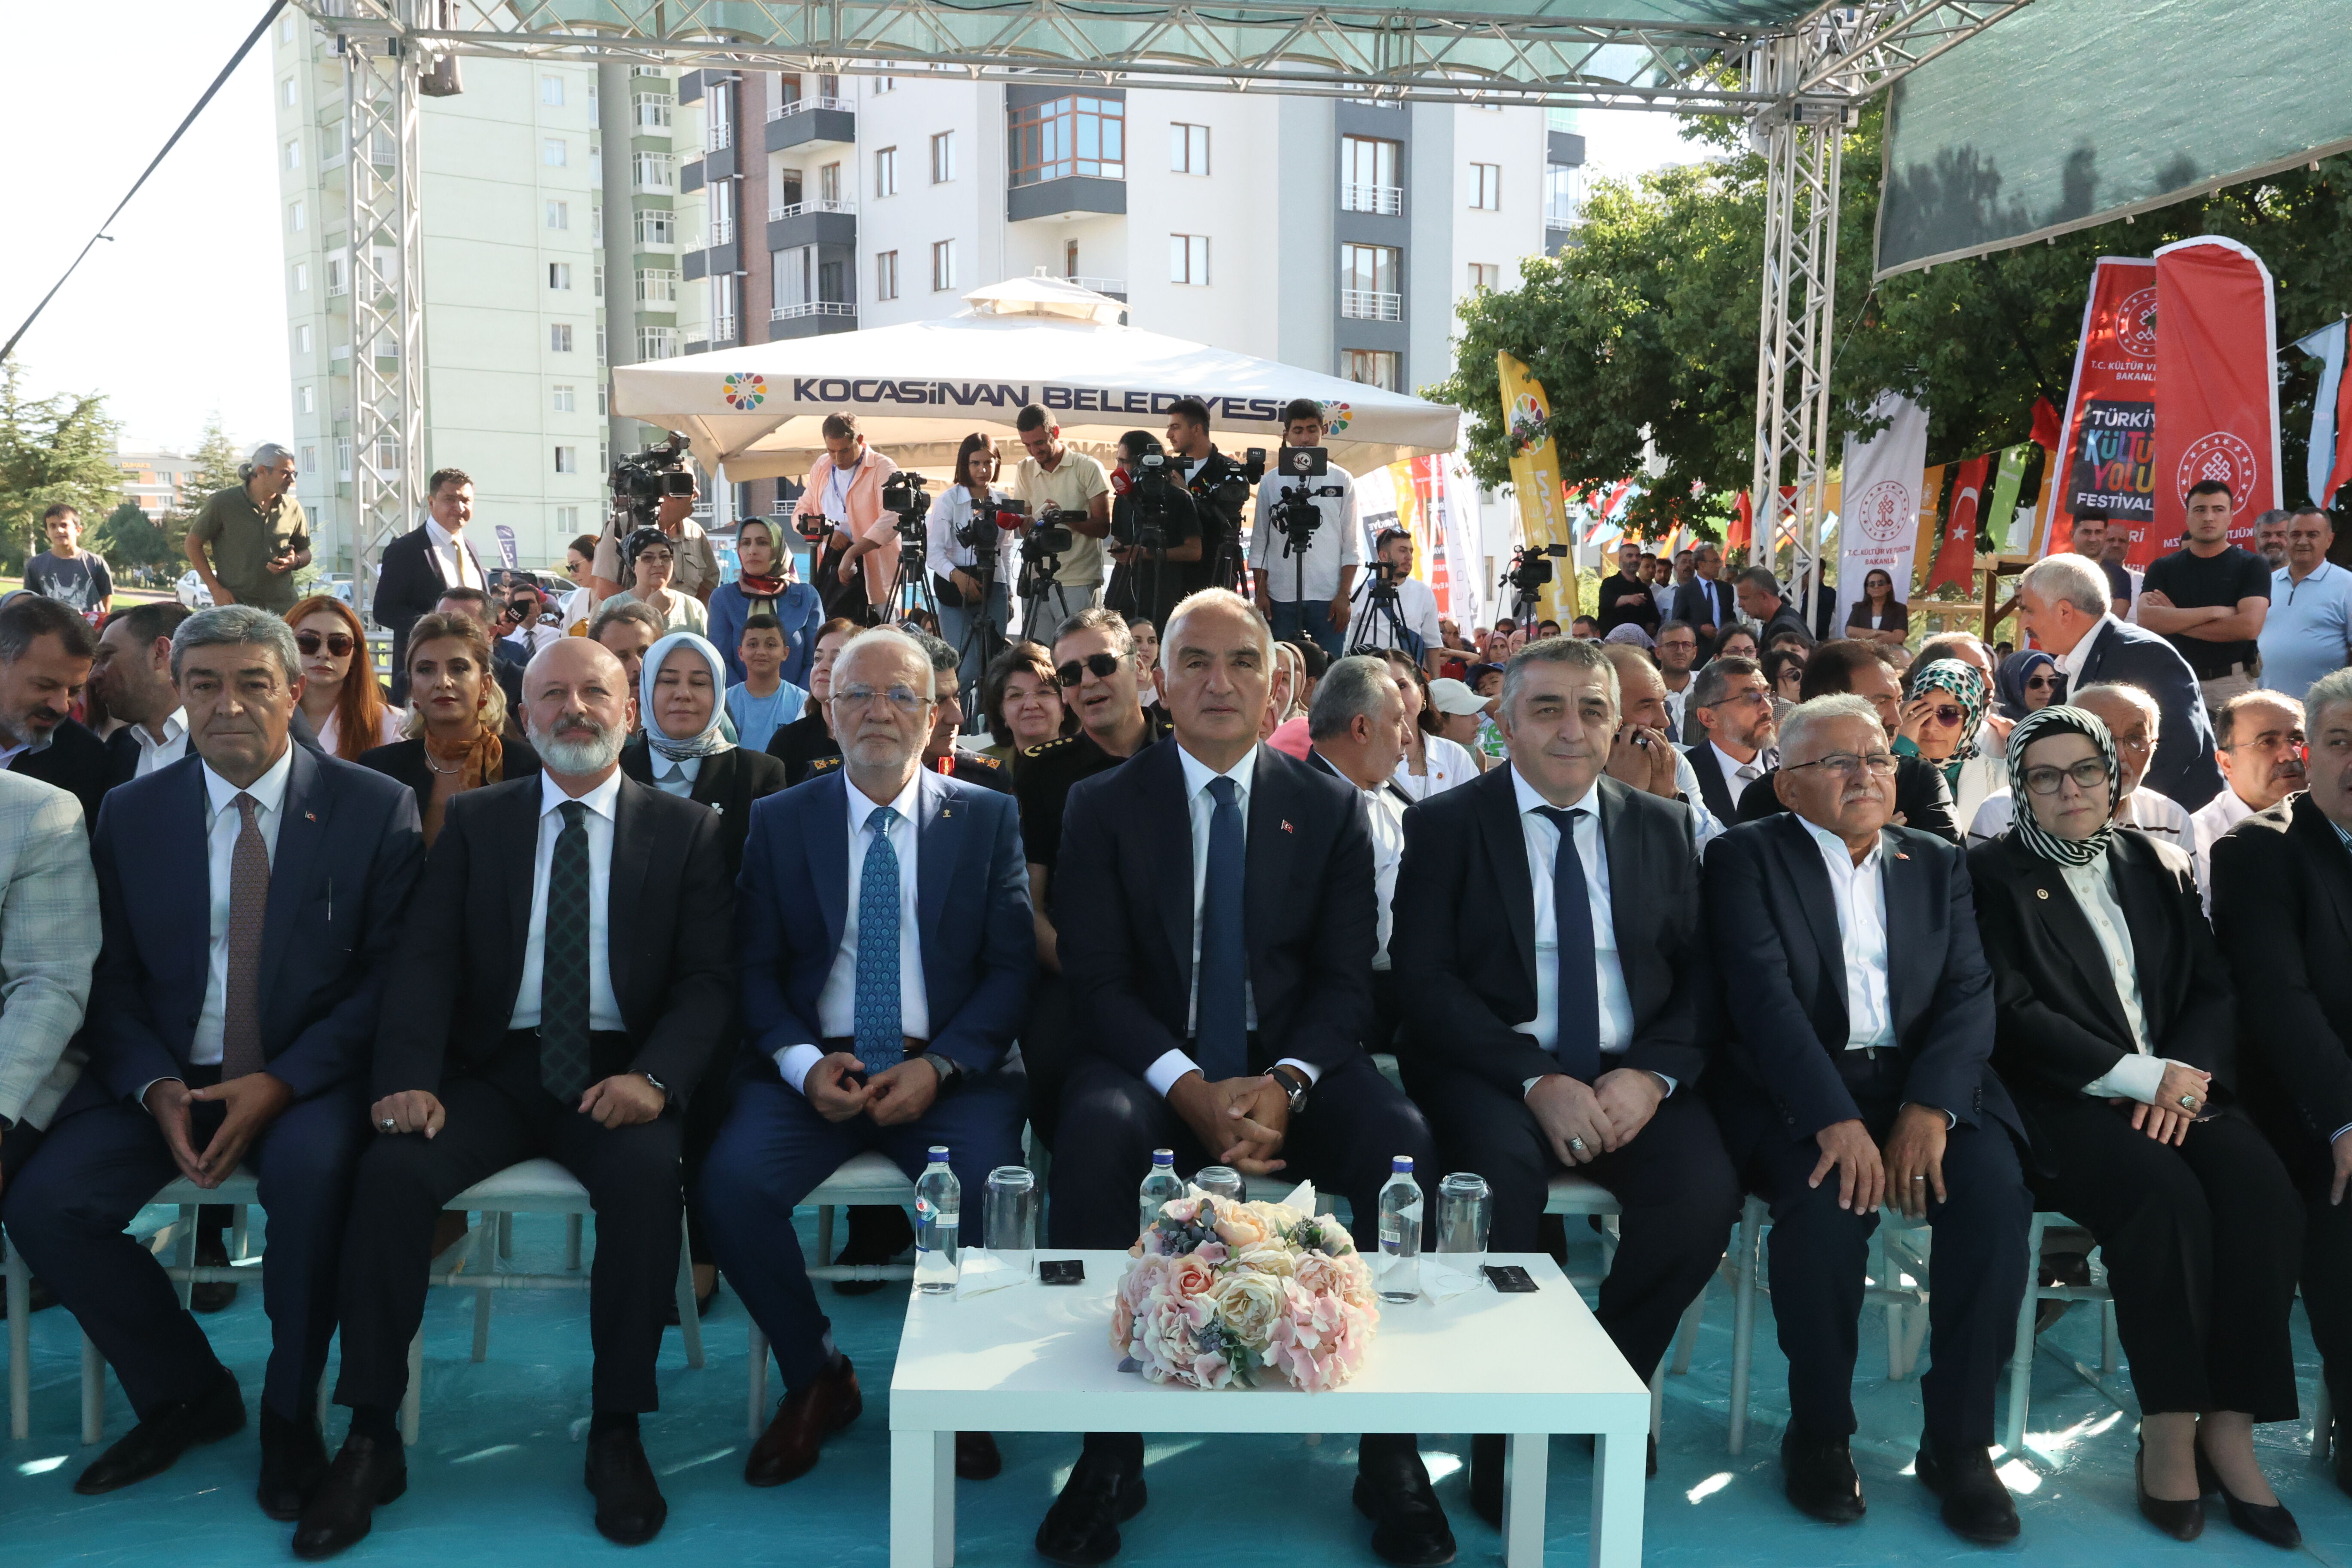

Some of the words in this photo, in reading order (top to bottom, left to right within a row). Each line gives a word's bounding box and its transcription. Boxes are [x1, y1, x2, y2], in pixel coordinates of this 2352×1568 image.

[2108, 361, 2144, 371] KÜLTÜR
[2116, 372, 2156, 381] BAKANL
[2084, 429, 2155, 466] KÜLTÜ
[2094, 459, 2155, 493] YOLU
[1861, 547, 1885, 555] KÜLTÜR
[510, 607, 522, 618] TRT
